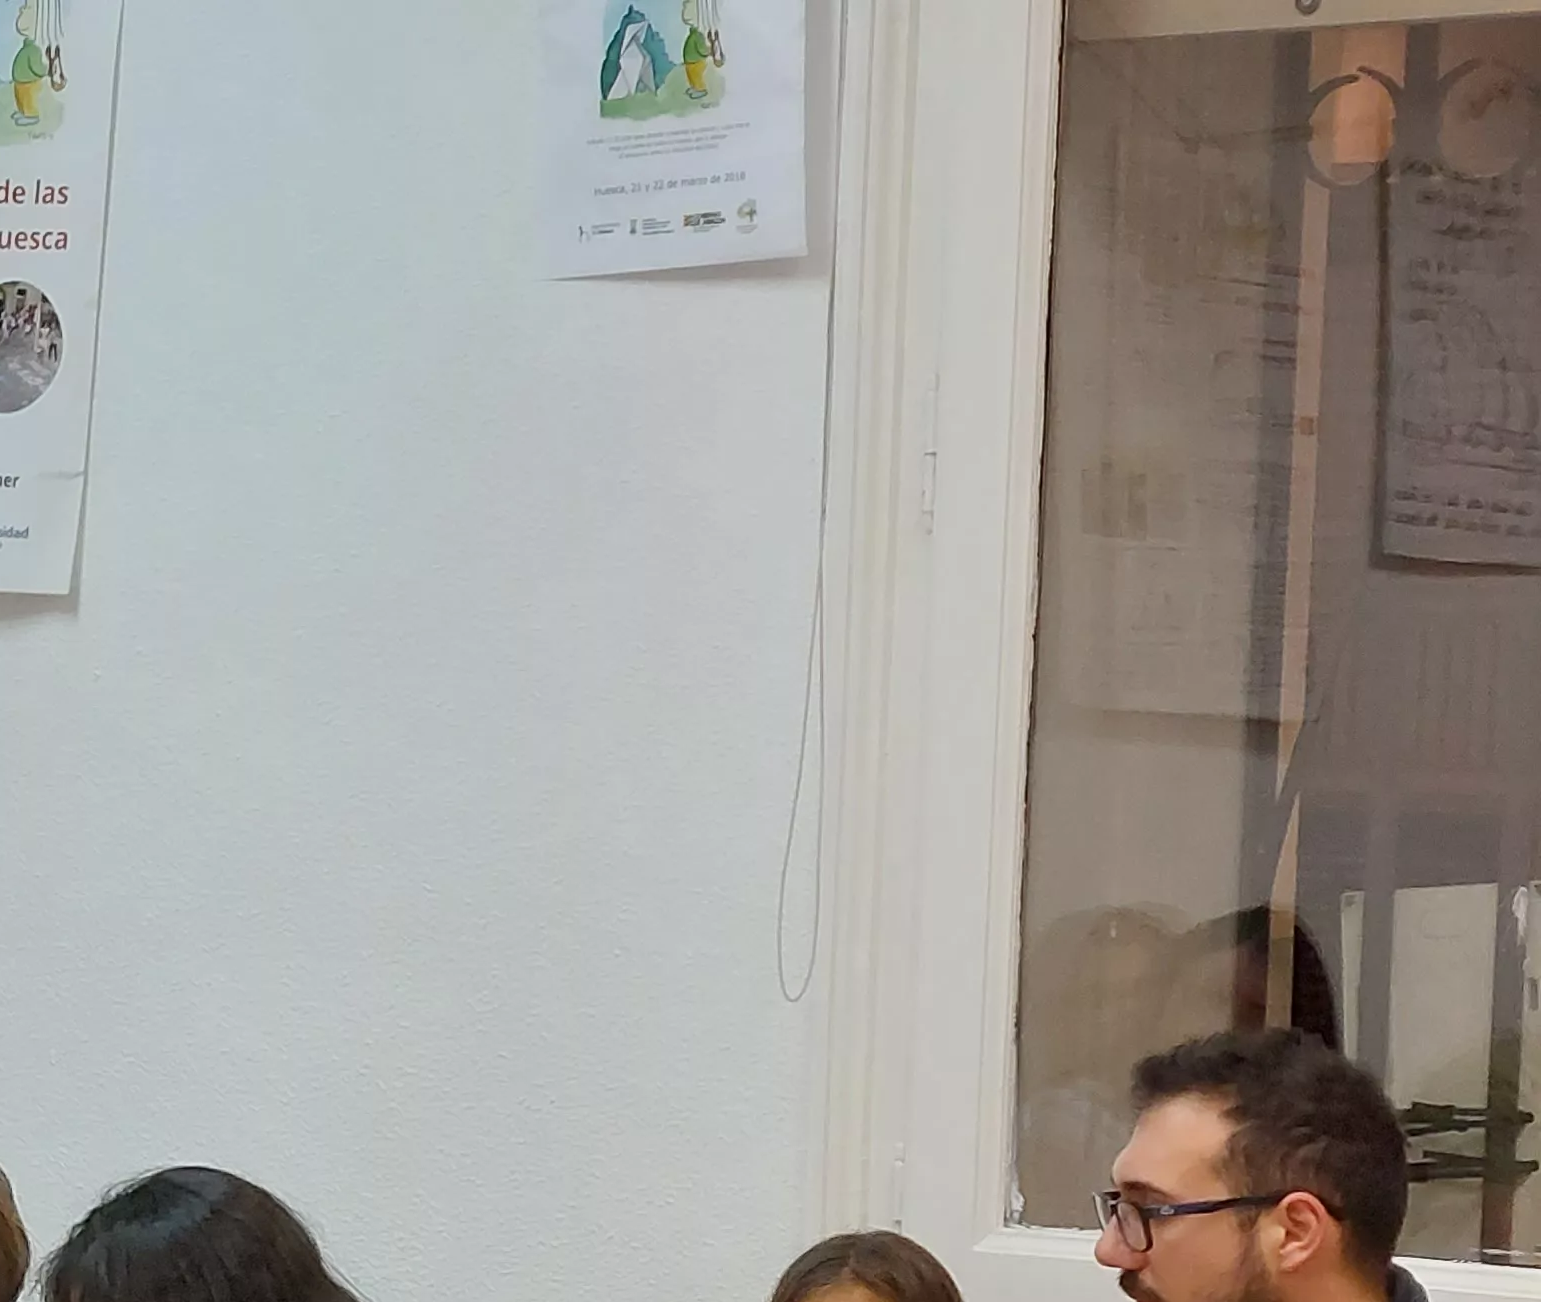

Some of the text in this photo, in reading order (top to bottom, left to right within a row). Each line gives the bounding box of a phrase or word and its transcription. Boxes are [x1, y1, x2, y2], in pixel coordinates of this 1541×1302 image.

[667, 178, 678, 189] de
[681, 176, 708, 187] marzo
[710, 173, 721, 184] de
[34, 180, 69, 206] las
